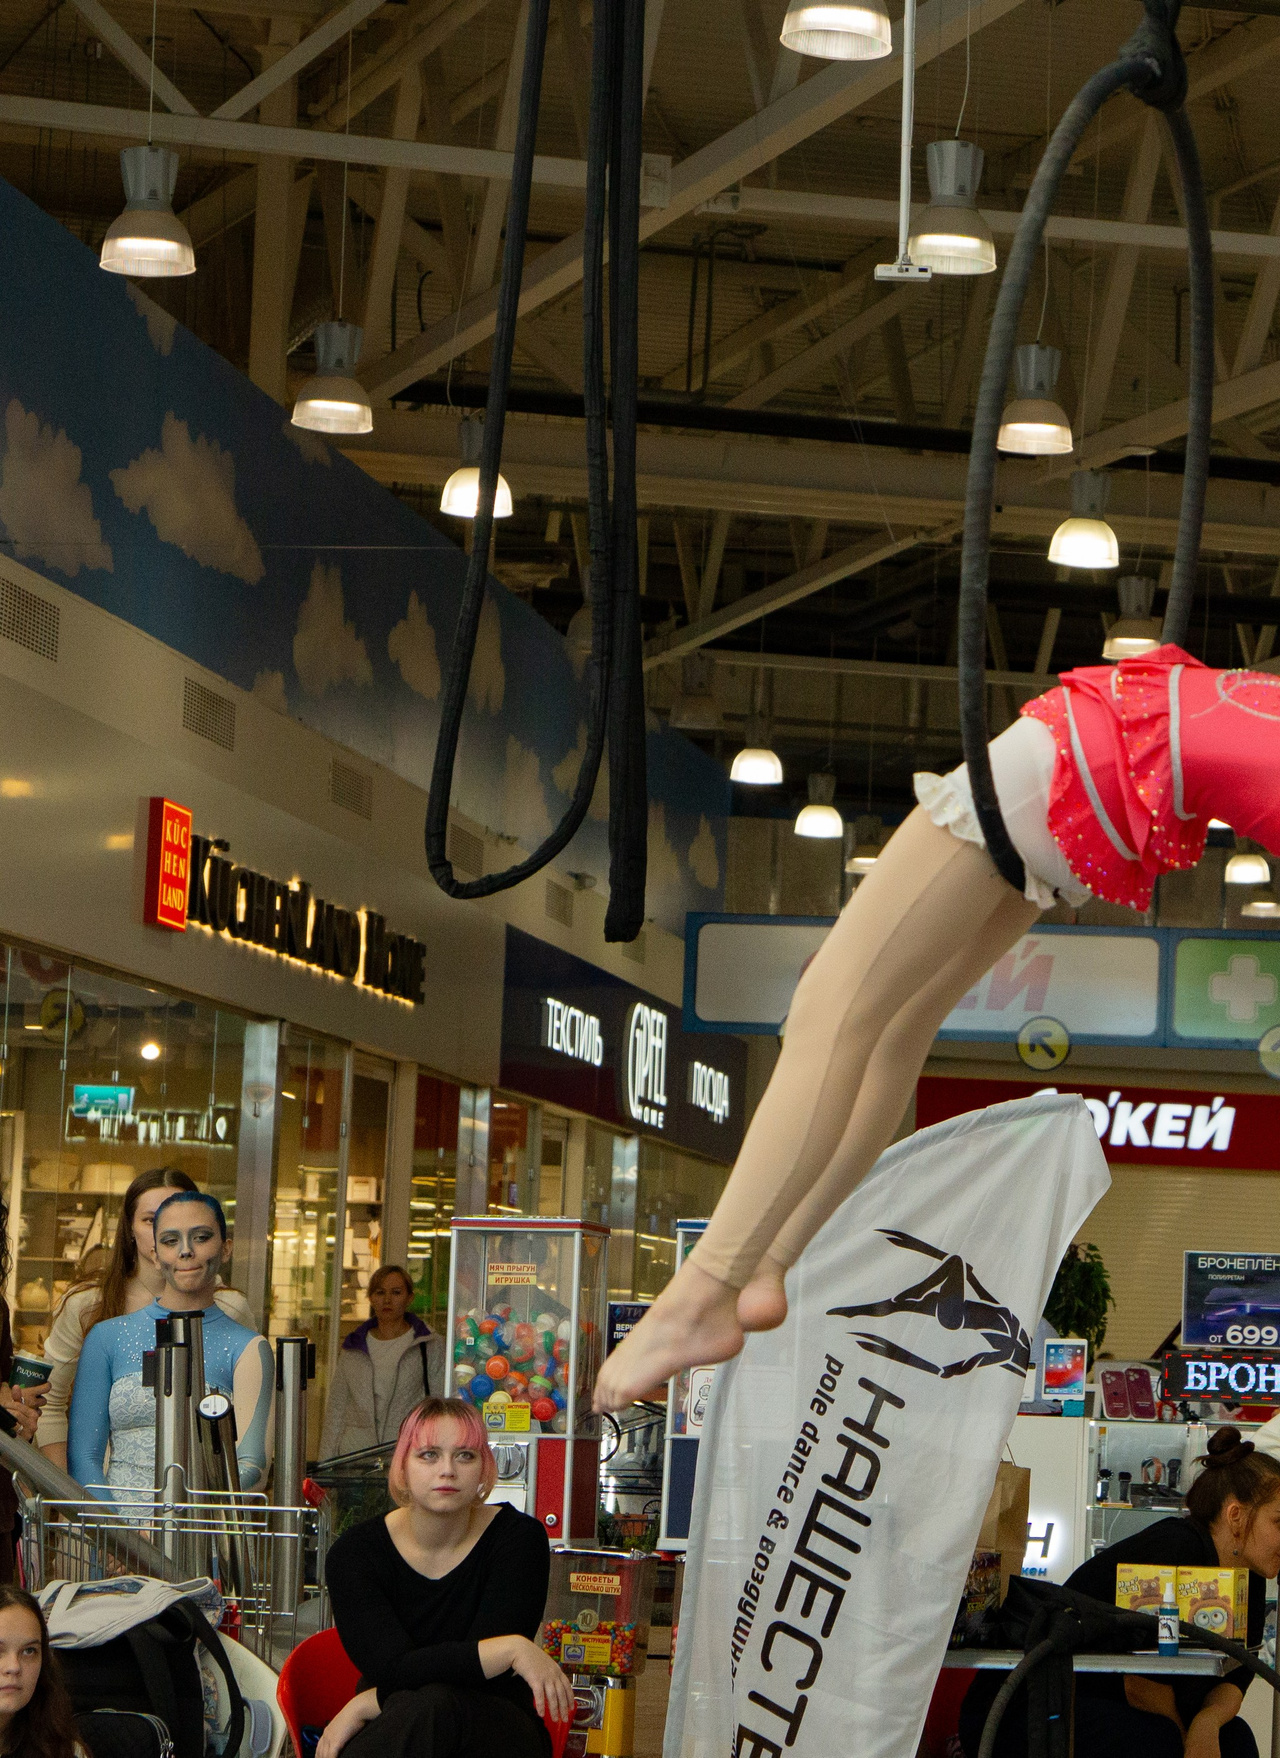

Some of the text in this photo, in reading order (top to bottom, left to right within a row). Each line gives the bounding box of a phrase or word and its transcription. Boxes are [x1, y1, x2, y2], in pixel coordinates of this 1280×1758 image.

[165, 819, 187, 850] KÜC
[163, 850, 186, 880] HEN
[161, 882, 185, 912] LAND
[547, 997, 604, 1067] ТЕКСТИЛЬ
[489, 1264, 536, 1272] МЯЧ ПРЫГУН
[494, 1276, 531, 1284] ИГРУШКА
[1209, 1334, 1223, 1343] ОТ
[1226, 1324, 1279, 1346] 699
[809, 1353, 844, 1417] pole
[776, 1420, 820, 1504] dance
[766, 1508, 790, 1530] &
[571, 1584, 604, 1592] НЕСКОЛЬКО
[575, 1574, 614, 1584] КОНФЕТЫ
